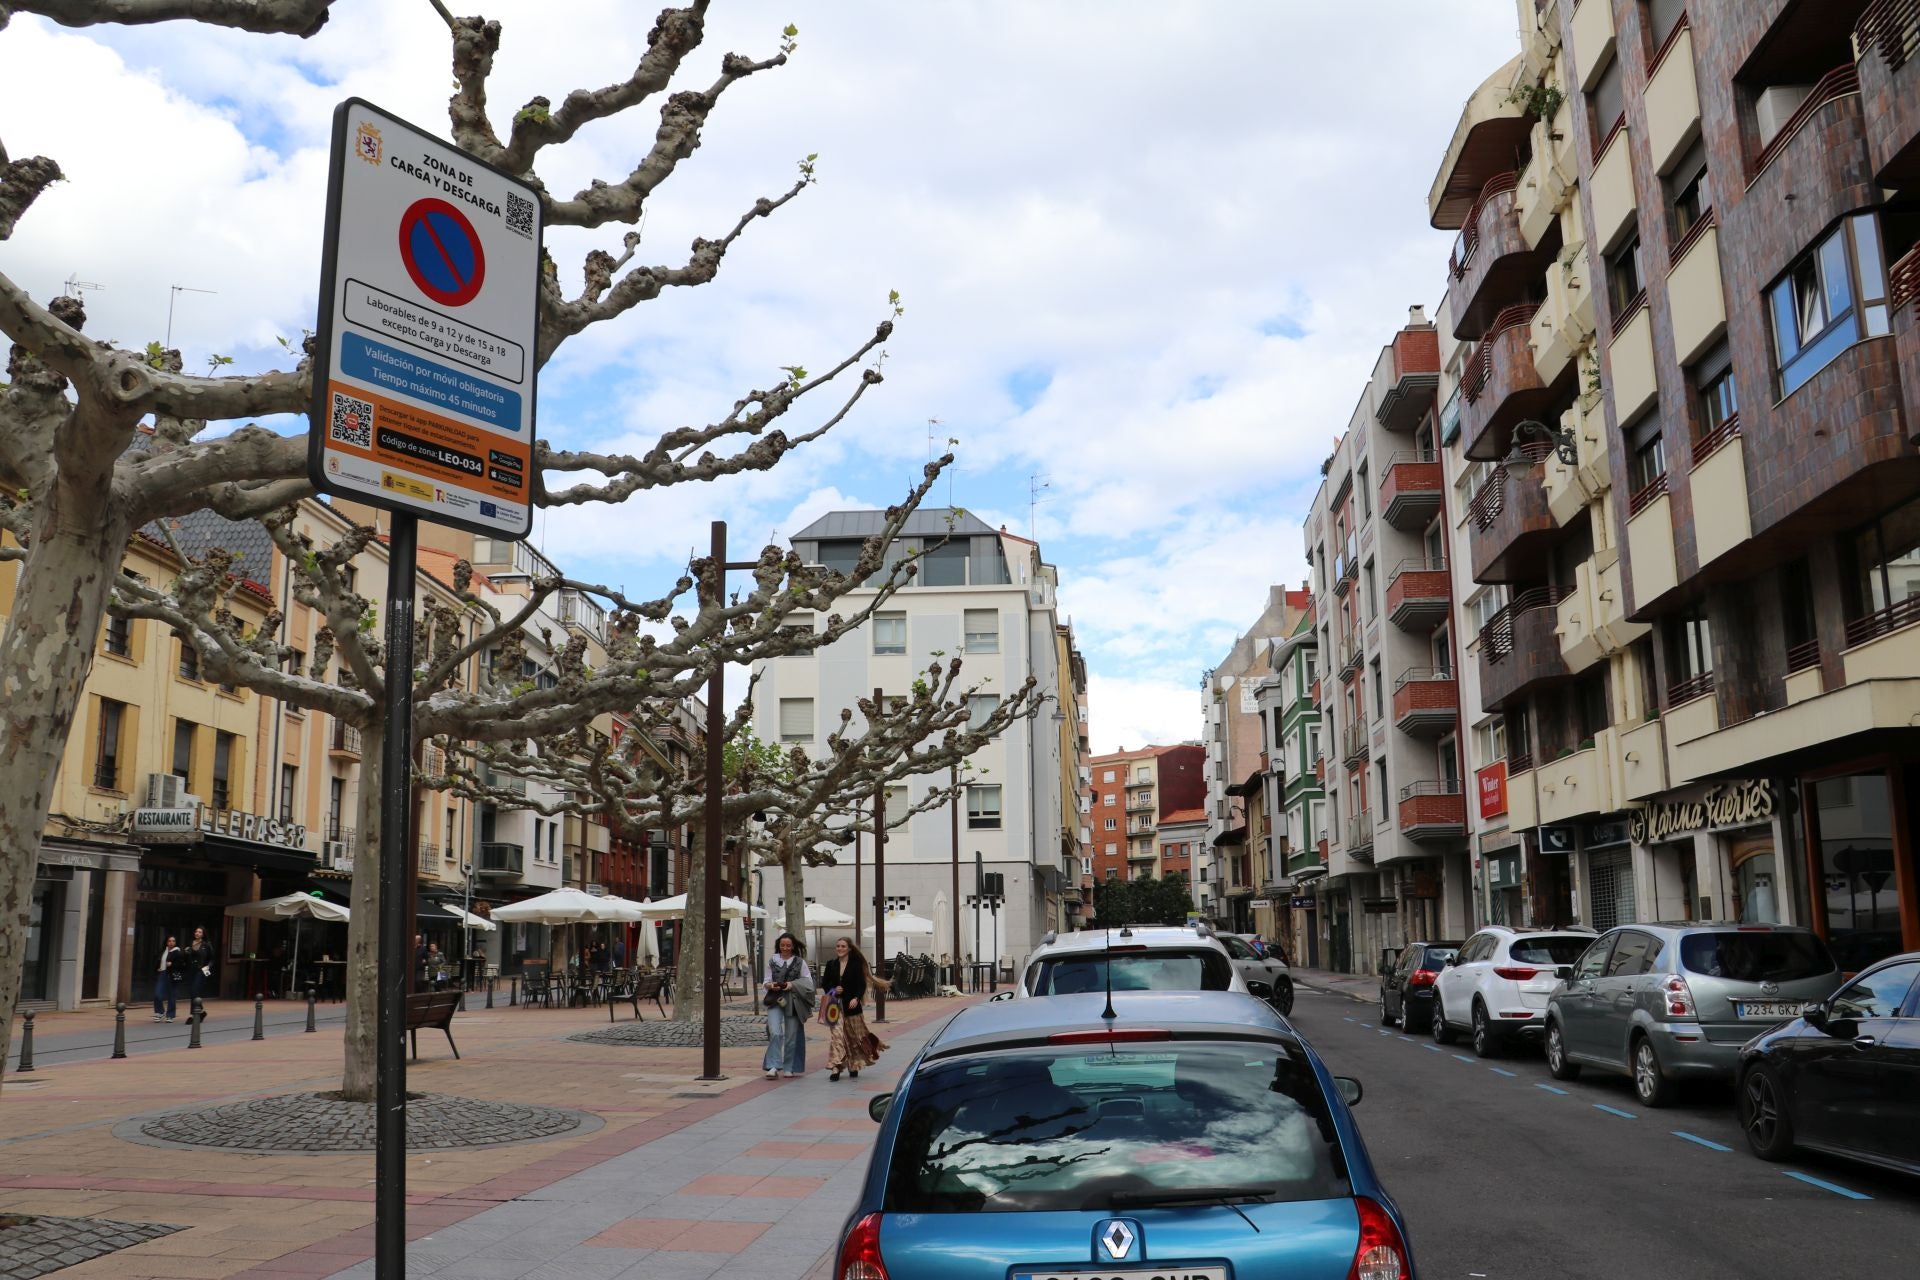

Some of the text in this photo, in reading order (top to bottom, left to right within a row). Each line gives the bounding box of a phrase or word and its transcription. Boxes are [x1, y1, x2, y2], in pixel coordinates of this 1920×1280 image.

[390, 156, 501, 218] CARGA Y DESCARGA
[423, 154, 473, 187] ZONA DE
[367, 296, 416, 322] Laborables
[418, 316, 430, 327] de
[431, 321, 437, 330] 9
[447, 327, 456, 338] 12
[458, 333, 463, 342] y
[465, 335, 475, 345] de
[478, 339, 487, 349] 15
[496, 346, 506, 357] 18
[382, 318, 491, 365] excepto Carga y Descarga
[365, 345, 504, 404] Validación por móvil obligatoria
[372, 366, 496, 418] Tiempo máximo 45 minutos
[381, 434, 407, 449] Código
[408, 442, 417, 451] de
[419, 447, 438, 457] zona:
[438, 451, 482, 472] LEO-034
[137, 812, 191, 826] RESTAURANTE
[1645, 779, 1772, 841] Marina Fuertes
[1746, 1004, 1799, 1016] 2234 GKZ
